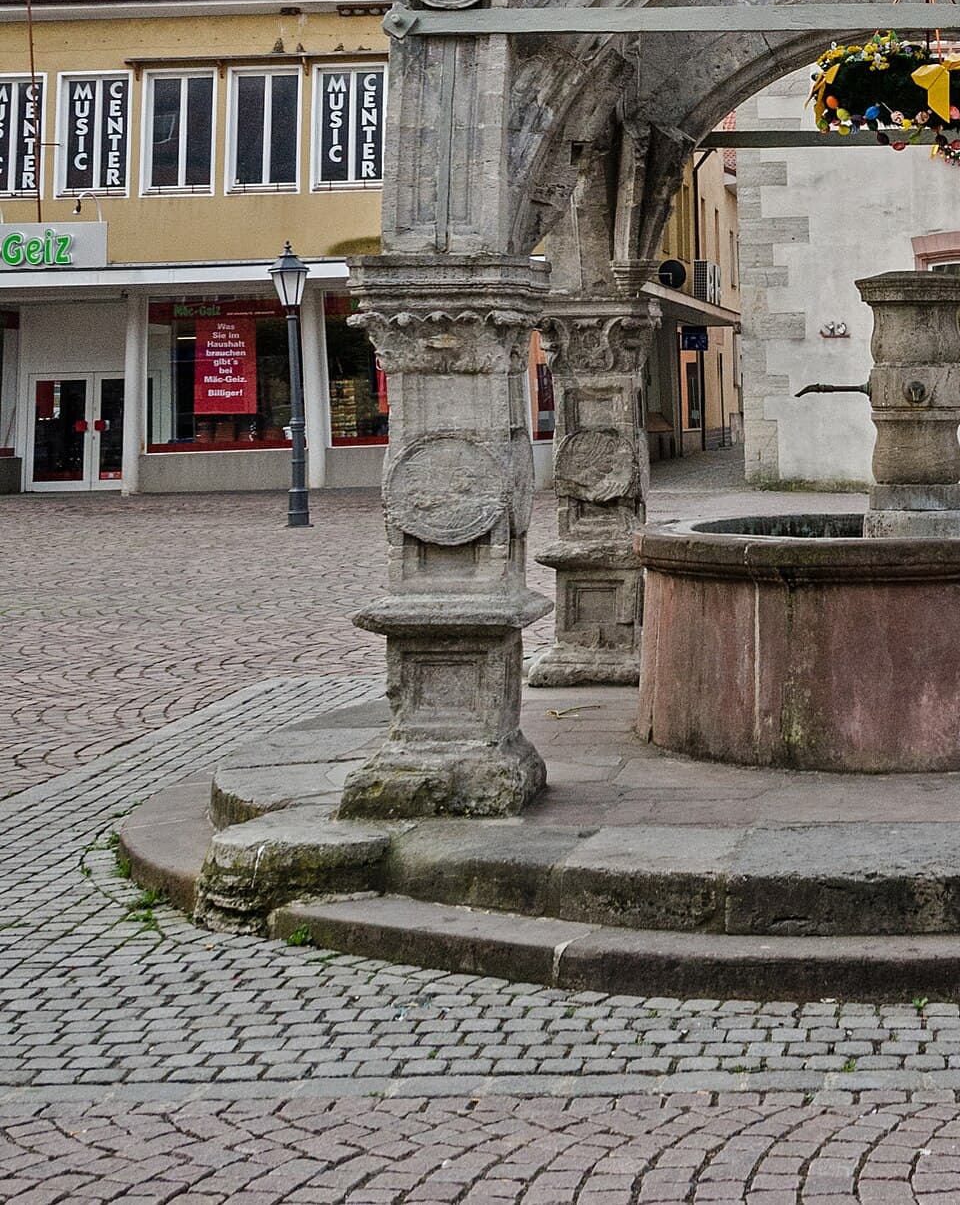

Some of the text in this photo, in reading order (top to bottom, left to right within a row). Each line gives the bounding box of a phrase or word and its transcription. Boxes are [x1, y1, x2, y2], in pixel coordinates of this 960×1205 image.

[22, 84, 40, 189] CENTER
[73, 83, 93, 171] MUSIC
[106, 81, 123, 186] CENTER
[327, 75, 347, 163] MUSIC
[361, 74, 378, 178] CENTER
[206, 349, 246, 357] brauchen
[212, 332, 226, 340] Sie
[217, 323, 235, 331] Was
[208, 389, 243, 398] Billiger!
